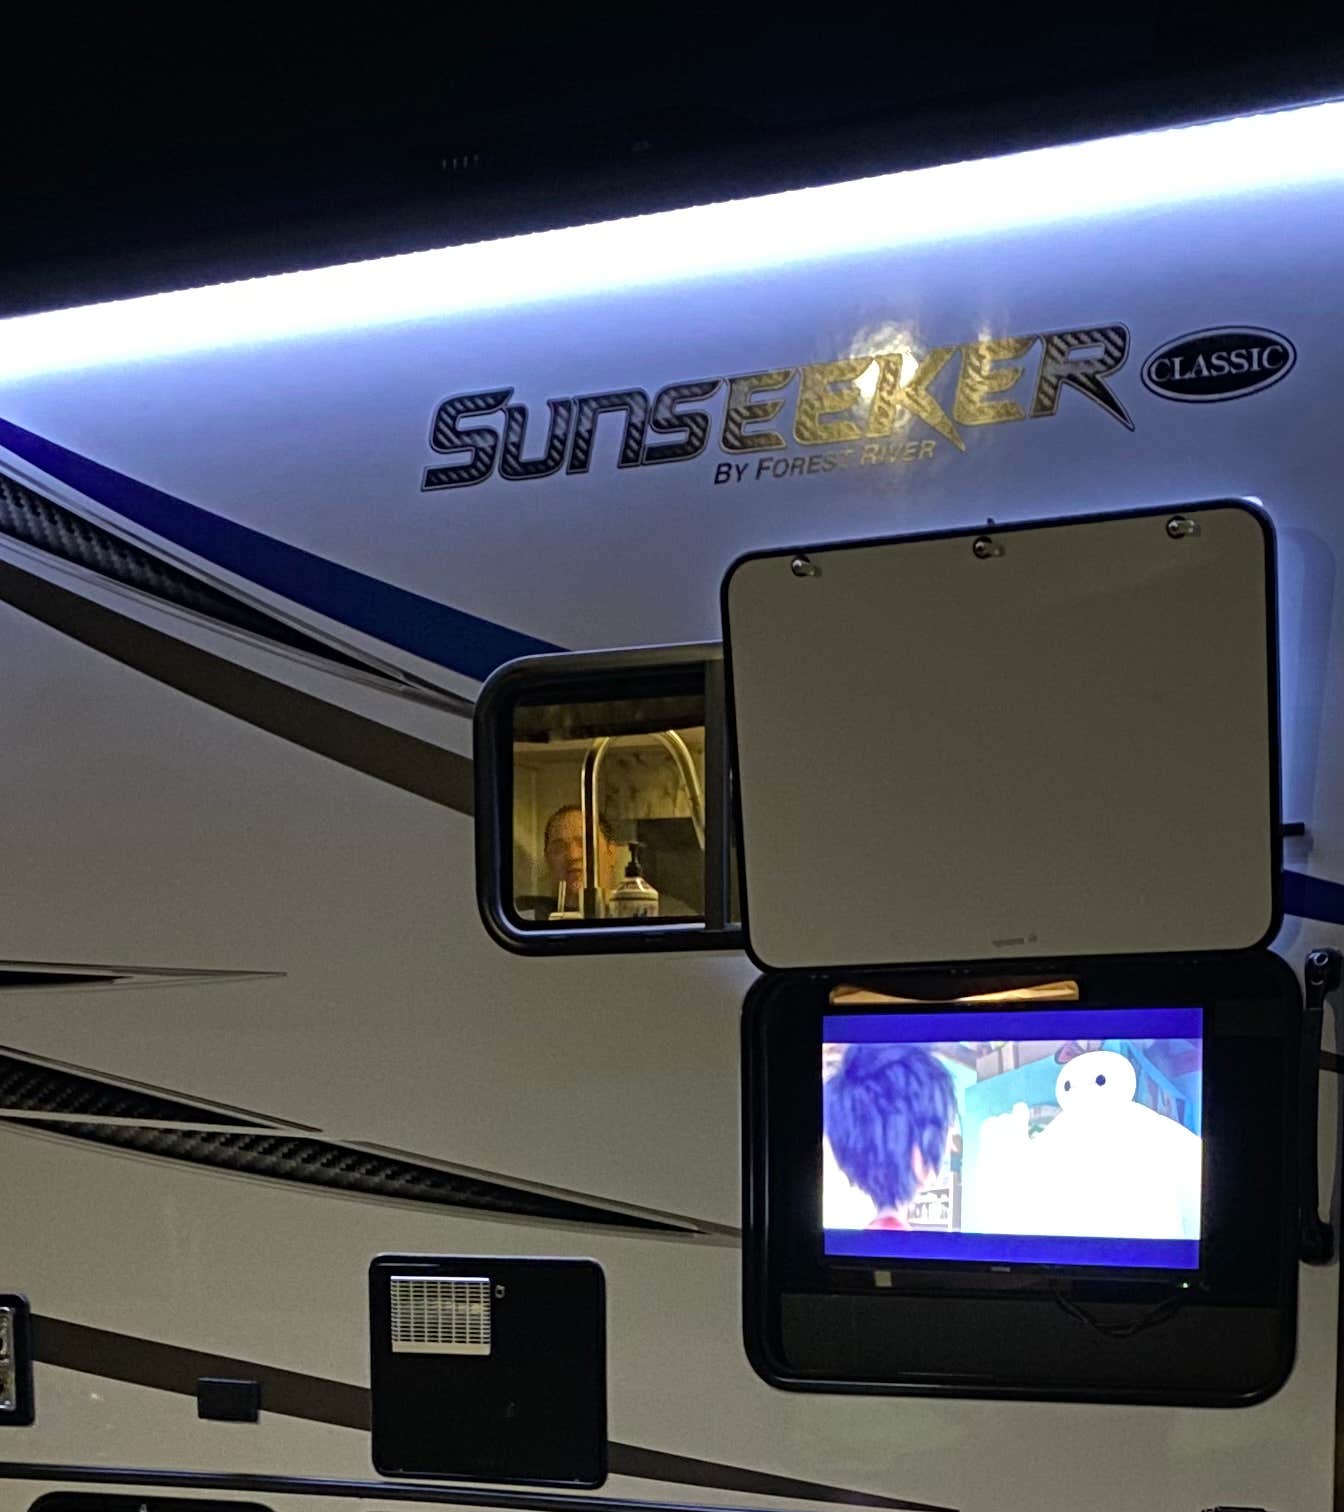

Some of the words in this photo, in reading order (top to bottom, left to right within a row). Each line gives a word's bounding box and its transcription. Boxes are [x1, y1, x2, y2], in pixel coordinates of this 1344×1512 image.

[1150, 345, 1284, 382] CLASSIC
[714, 462, 748, 485] BY
[860, 440, 936, 466] RIVER
